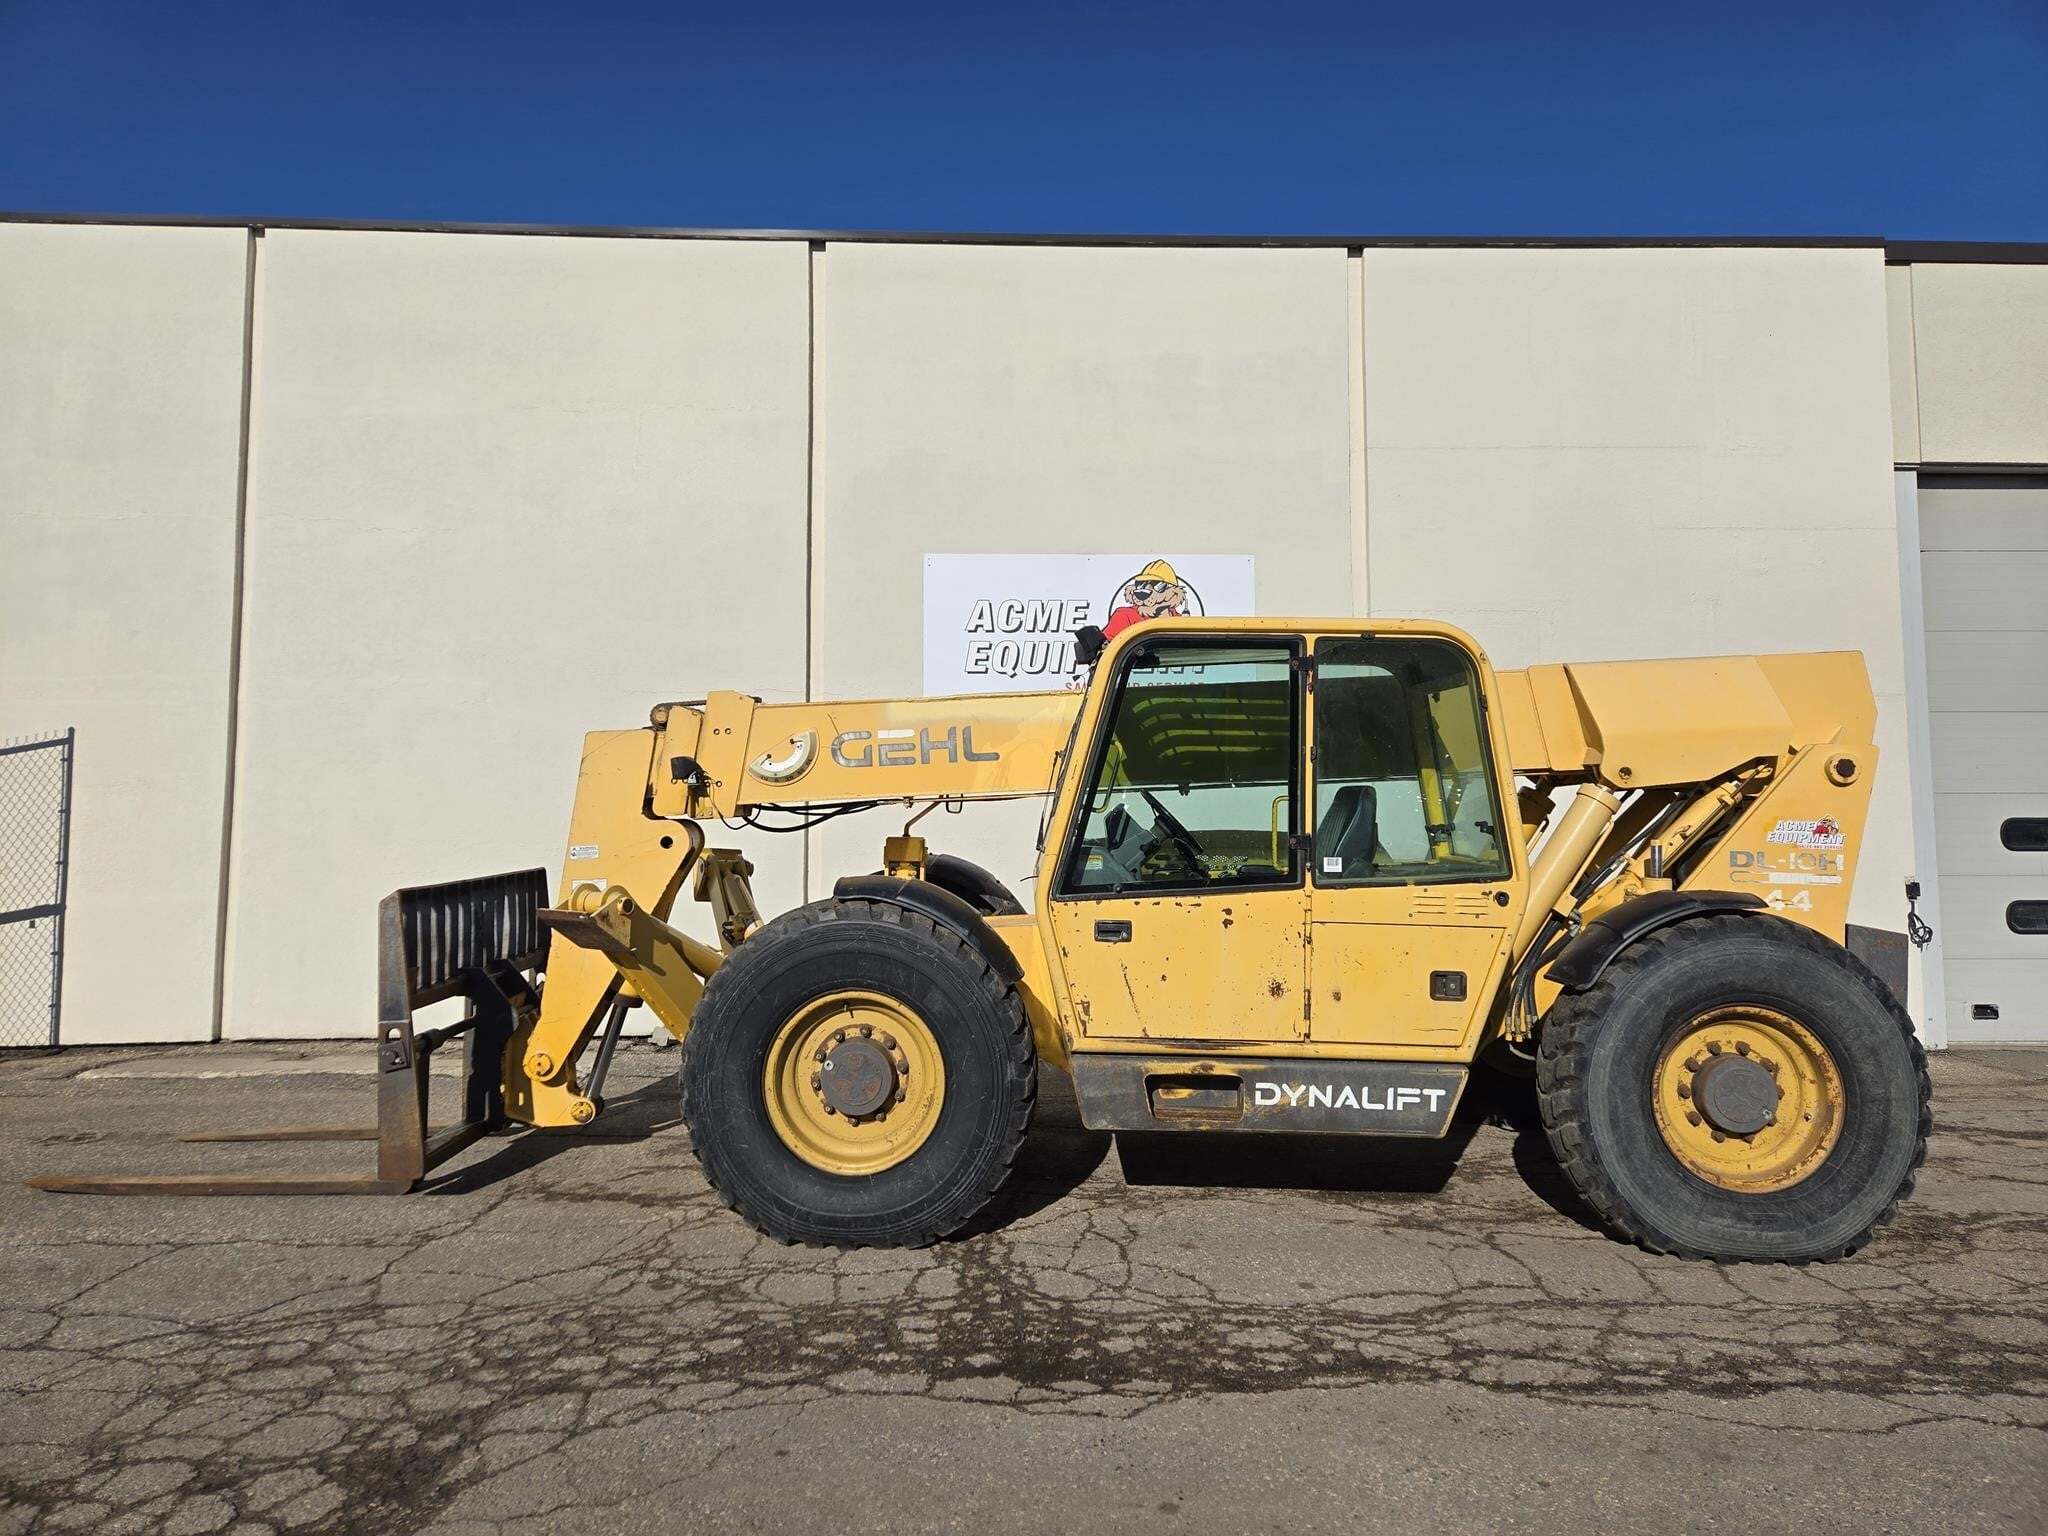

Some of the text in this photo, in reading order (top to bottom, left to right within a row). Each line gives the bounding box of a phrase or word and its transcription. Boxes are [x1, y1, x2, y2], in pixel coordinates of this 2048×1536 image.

[965, 599, 1090, 633] ACME
[830, 725, 1001, 768] GEHL
[1768, 831, 1846, 845] EQUIPMENT
[1777, 821, 1816, 832] ACME
[1255, 1082, 1446, 1112] DYNALIFT
